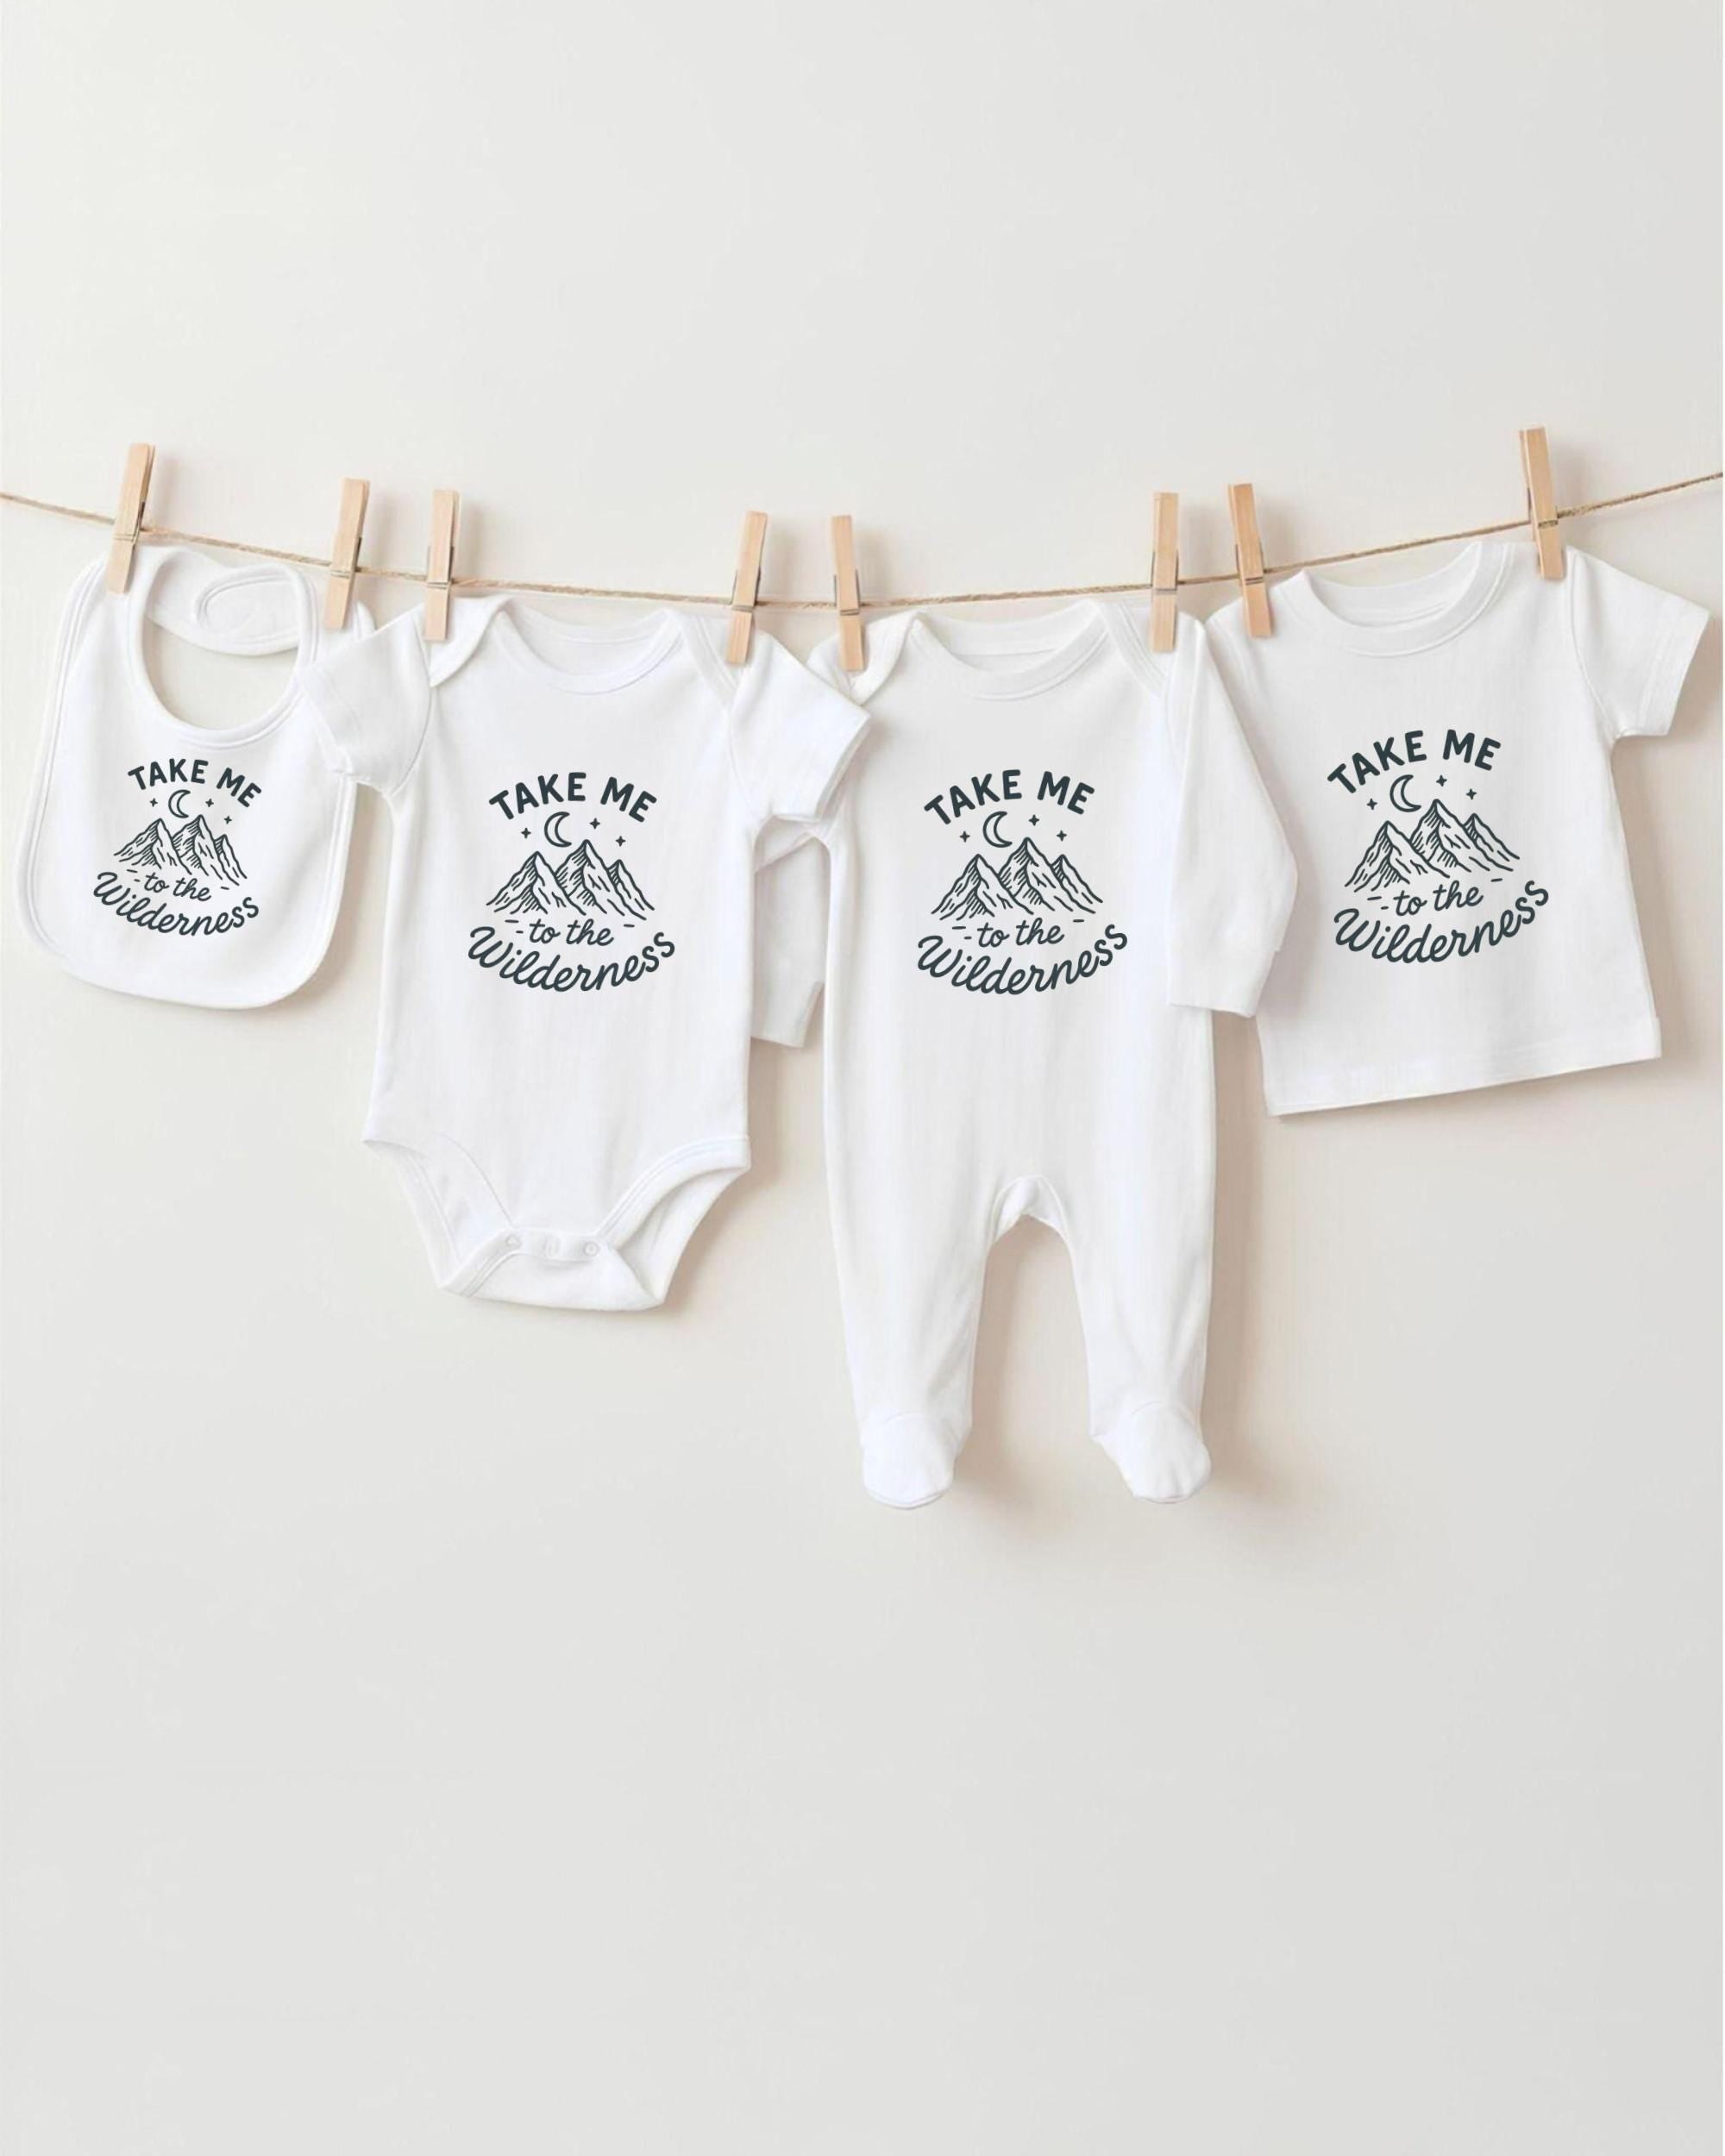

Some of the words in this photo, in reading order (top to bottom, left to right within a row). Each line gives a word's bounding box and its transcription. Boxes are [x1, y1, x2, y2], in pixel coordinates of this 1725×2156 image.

[128, 758, 209, 790] TAKE
[216, 767, 262, 808] ME
[1327, 730, 1427, 794] TAKE
[1442, 729, 1502, 772] ME
[488, 772, 586, 820] TAKE
[600, 776, 657, 823] ME
[924, 769, 1023, 825] TAKE
[1037, 770, 1095, 815] ME
[93, 871, 260, 937] Wilderness
[144, 872, 170, 893] to
[172, 877, 212, 902] the
[1393, 889, 1428, 917] to
[1433, 880, 1484, 912] the
[529, 918, 561, 944] to
[565, 918, 615, 947] the
[976, 922, 1010, 948] to
[1015, 917, 1065, 946] the
[1333, 880, 1549, 964] Wilderness
[467, 926, 675, 993] Wilderness
[917, 924, 1128, 995] Wilderness
